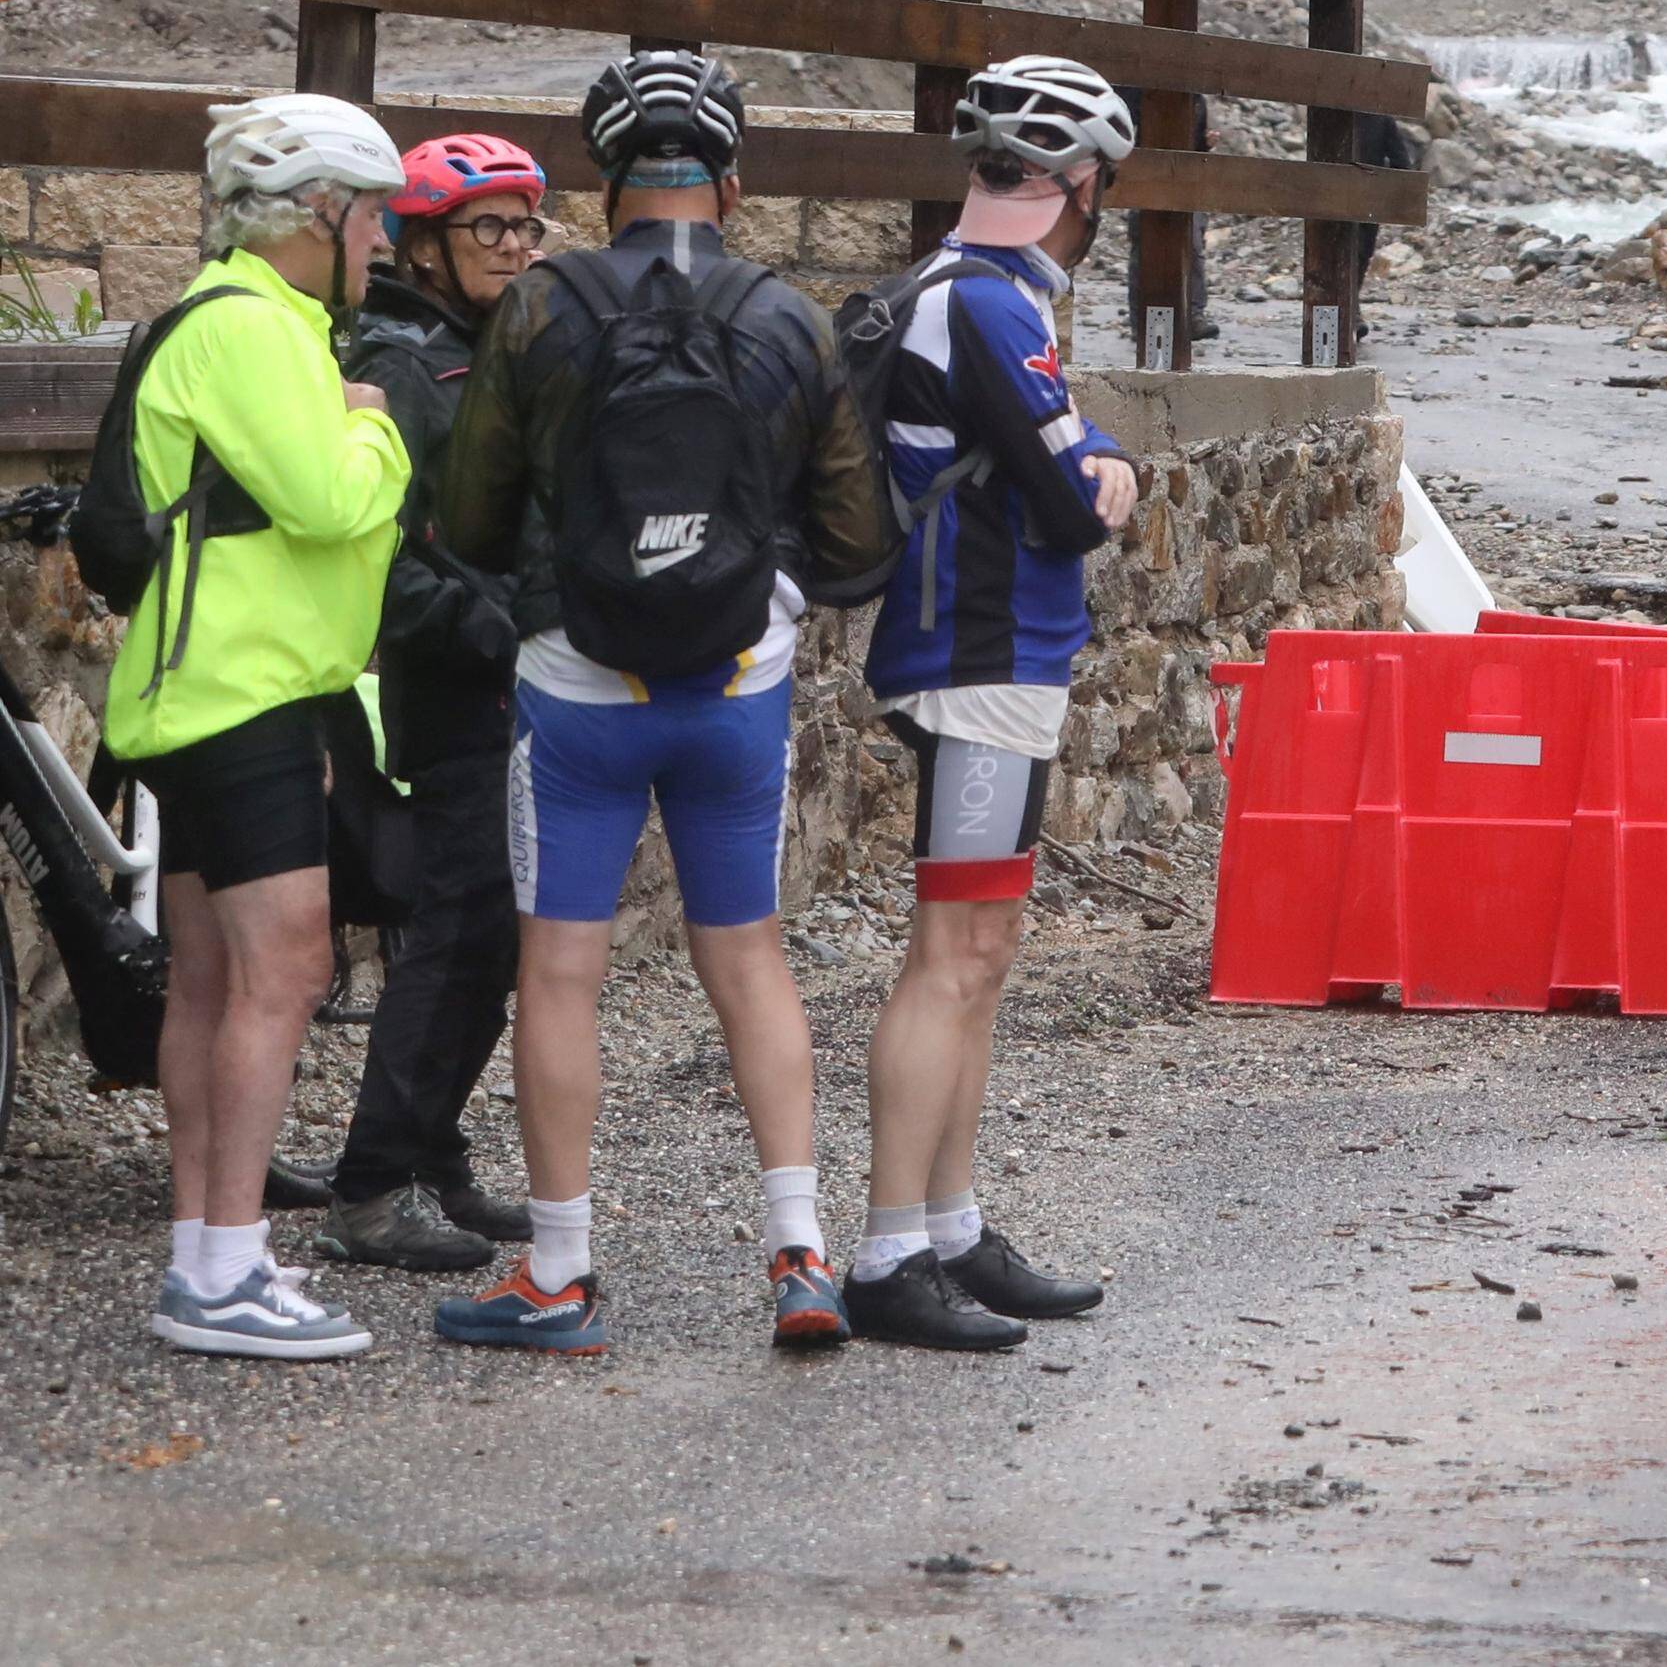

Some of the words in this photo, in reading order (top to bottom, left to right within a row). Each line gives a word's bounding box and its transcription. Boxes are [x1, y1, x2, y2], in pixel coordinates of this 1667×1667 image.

[637, 513, 710, 550] NIKE
[509, 755, 530, 884] QUIBERON
[518, 1302, 580, 1325] SCARPA
